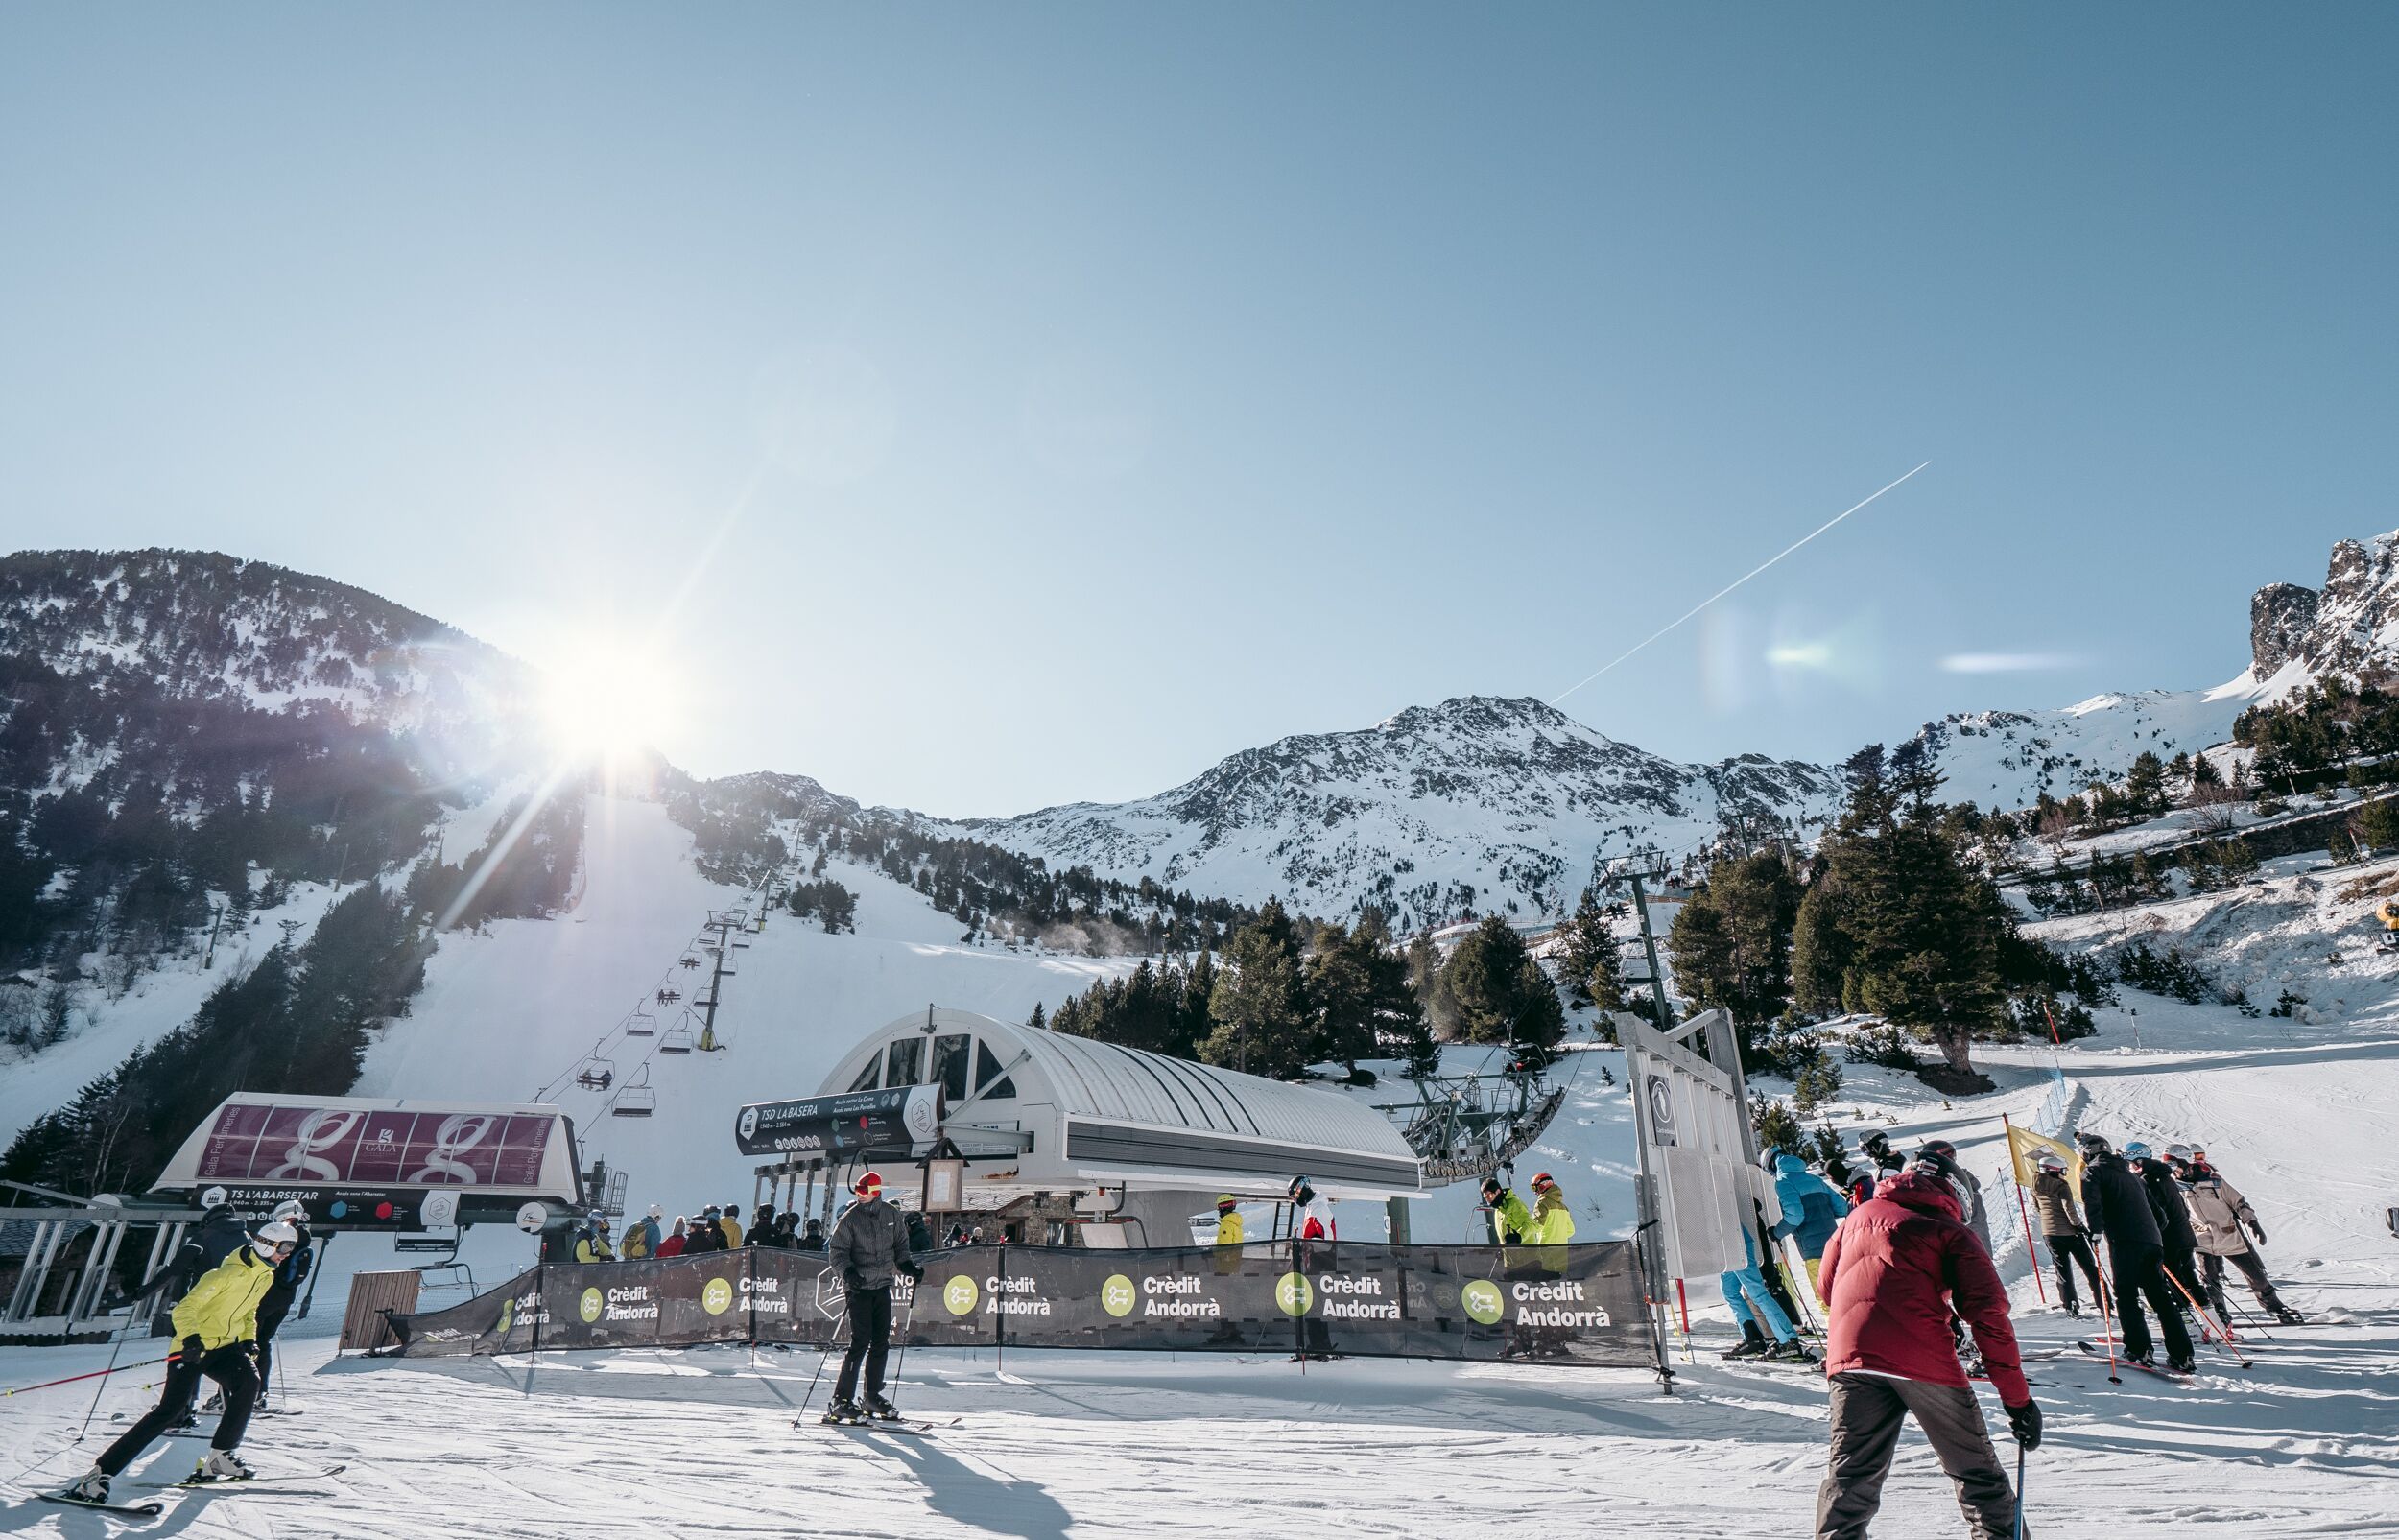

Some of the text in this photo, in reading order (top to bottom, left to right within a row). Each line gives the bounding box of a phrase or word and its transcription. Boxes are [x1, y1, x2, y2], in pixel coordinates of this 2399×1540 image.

[761, 1109, 775, 1121] TSD
[204, 1106, 241, 1176] Gala Perfumeries
[523, 1119, 548, 1184] Gala Perfumeries
[231, 1190, 319, 1200] TS L'ABARSETAR
[739, 1276, 778, 1292] Crèdit
[986, 1276, 1036, 1293] Crèdit
[1143, 1276, 1201, 1294] Crèdit
[1319, 1275, 1381, 1295] Crèdit
[1512, 1281, 1584, 1301] Crèdit
[514, 1292, 542, 1311] Cdit
[607, 1286, 648, 1302] Crèdit
[606, 1303, 659, 1321] Andorrà
[738, 1295, 788, 1314] Andorrà
[985, 1297, 1051, 1315] Andorrà
[1144, 1297, 1221, 1316] Andorrà
[1322, 1298, 1401, 1319] Andorrà
[513, 1309, 550, 1326] dorrà
[1516, 1305, 1611, 1327] Andorrà
